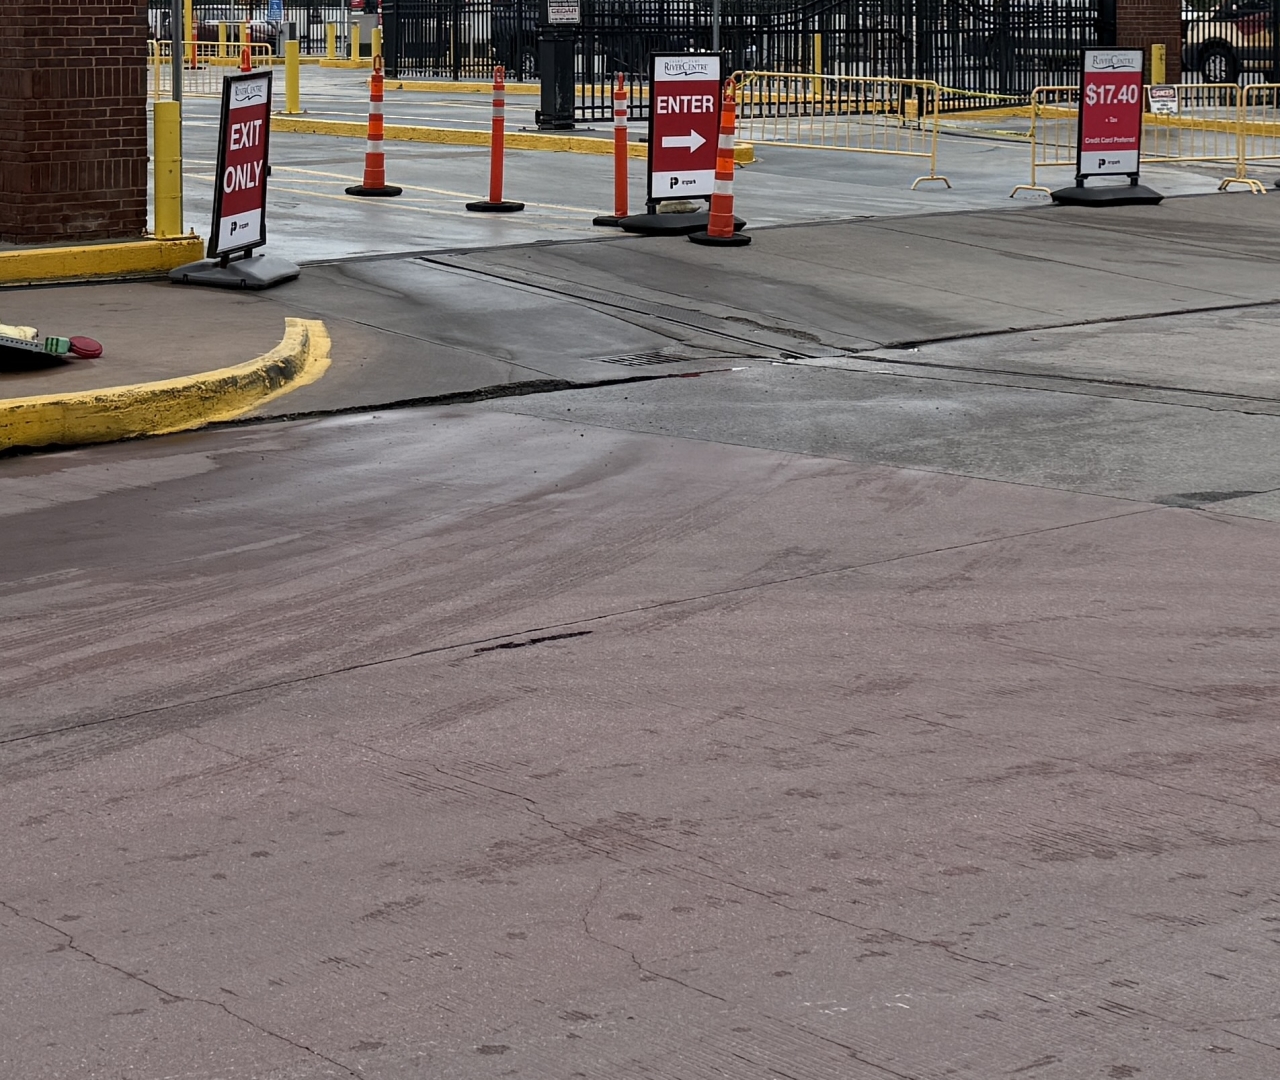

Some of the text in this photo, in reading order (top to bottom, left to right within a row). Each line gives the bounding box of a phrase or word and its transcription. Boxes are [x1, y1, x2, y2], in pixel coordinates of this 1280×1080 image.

[656, 95, 714, 114] ENTER
[1086, 82, 1138, 106] $17.40
[230, 119, 263, 151] EXIT
[223, 160, 263, 194] ONLY
